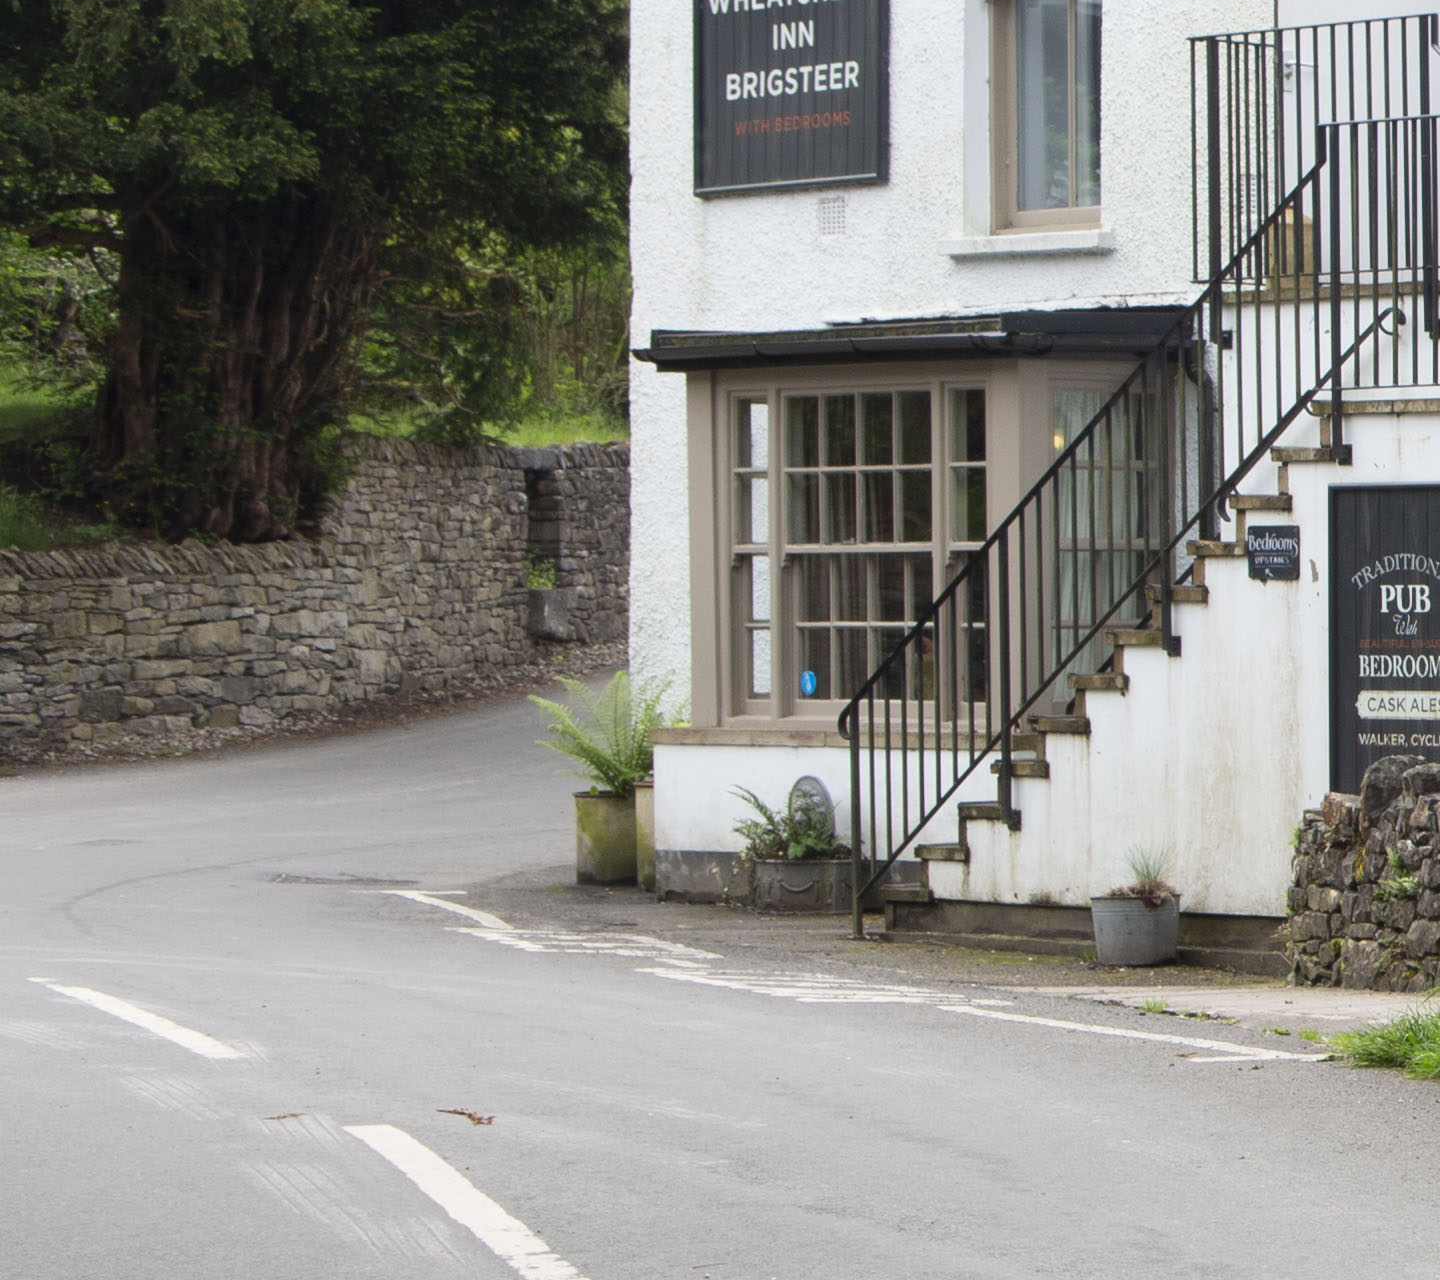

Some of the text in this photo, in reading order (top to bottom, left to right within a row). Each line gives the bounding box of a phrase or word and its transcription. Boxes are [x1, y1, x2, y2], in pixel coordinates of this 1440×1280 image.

[772, 20, 815, 51] INN
[725, 60, 859, 102] BRIGSTEER
[733, 111, 851, 136] WITH BEDROOMS
[1248, 532, 1299, 558] Bedrooms
[1380, 584, 1431, 613] PUB
[1392, 614, 1418, 636] With
[1367, 697, 1406, 713] CASK
[1358, 733, 1408, 748] WALKER,
